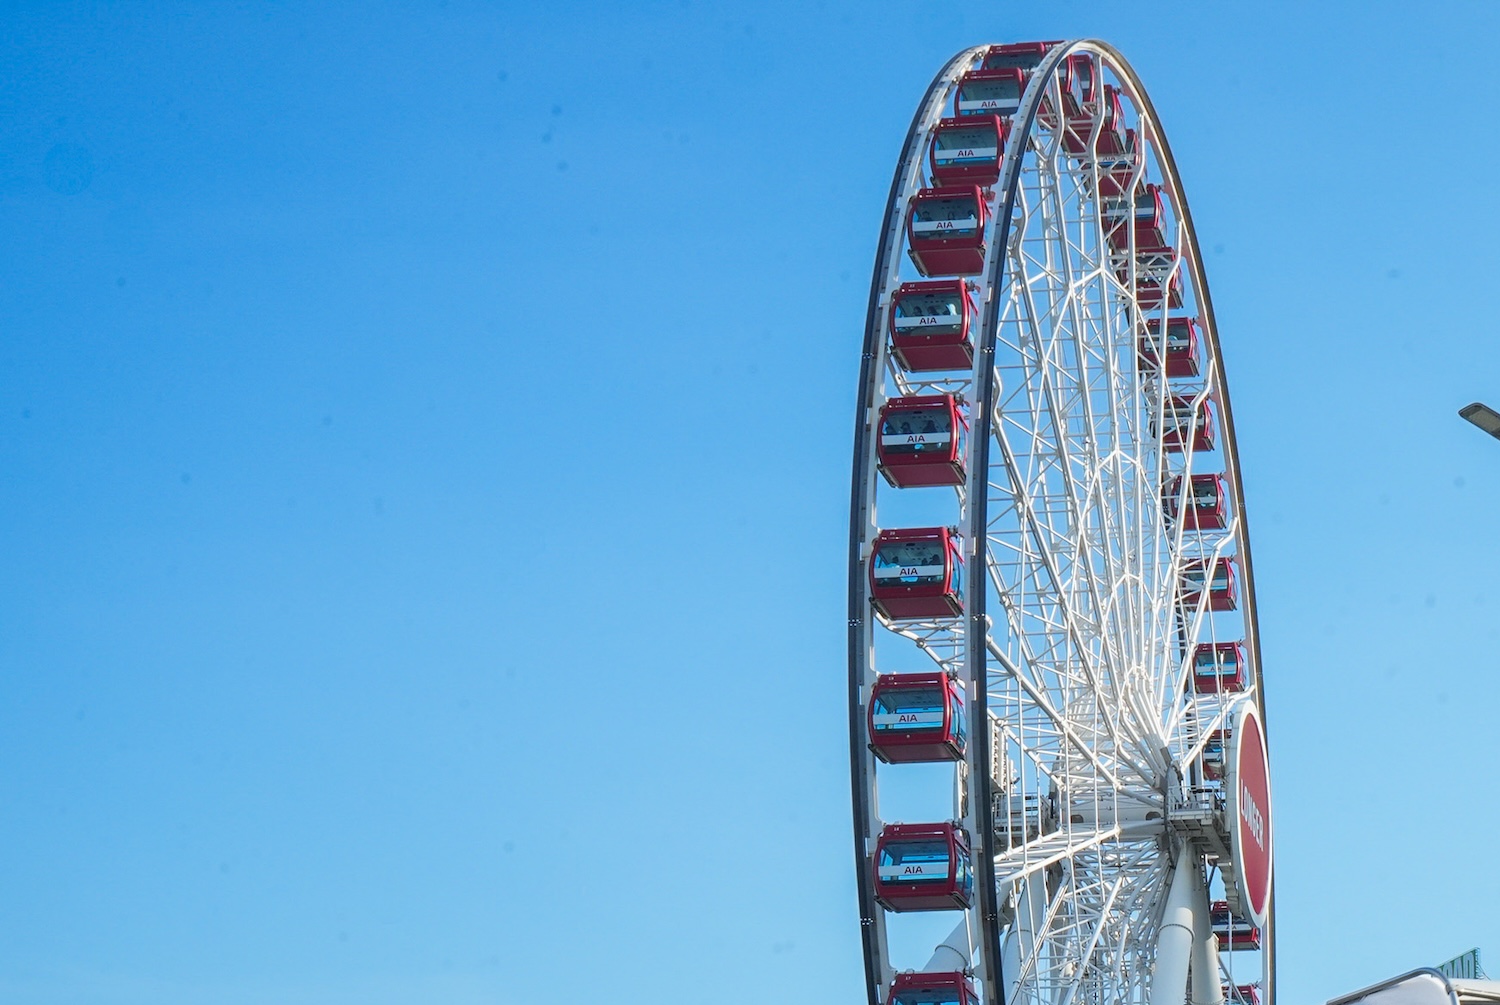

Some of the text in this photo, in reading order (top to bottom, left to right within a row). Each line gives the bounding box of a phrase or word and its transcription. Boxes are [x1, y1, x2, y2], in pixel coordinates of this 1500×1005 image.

[919, 317, 937, 325] AIA
[907, 435, 925, 443] AIA
[900, 568, 918, 576] AIA
[899, 714, 918, 722] AIA
[904, 866, 923, 874] AIA
